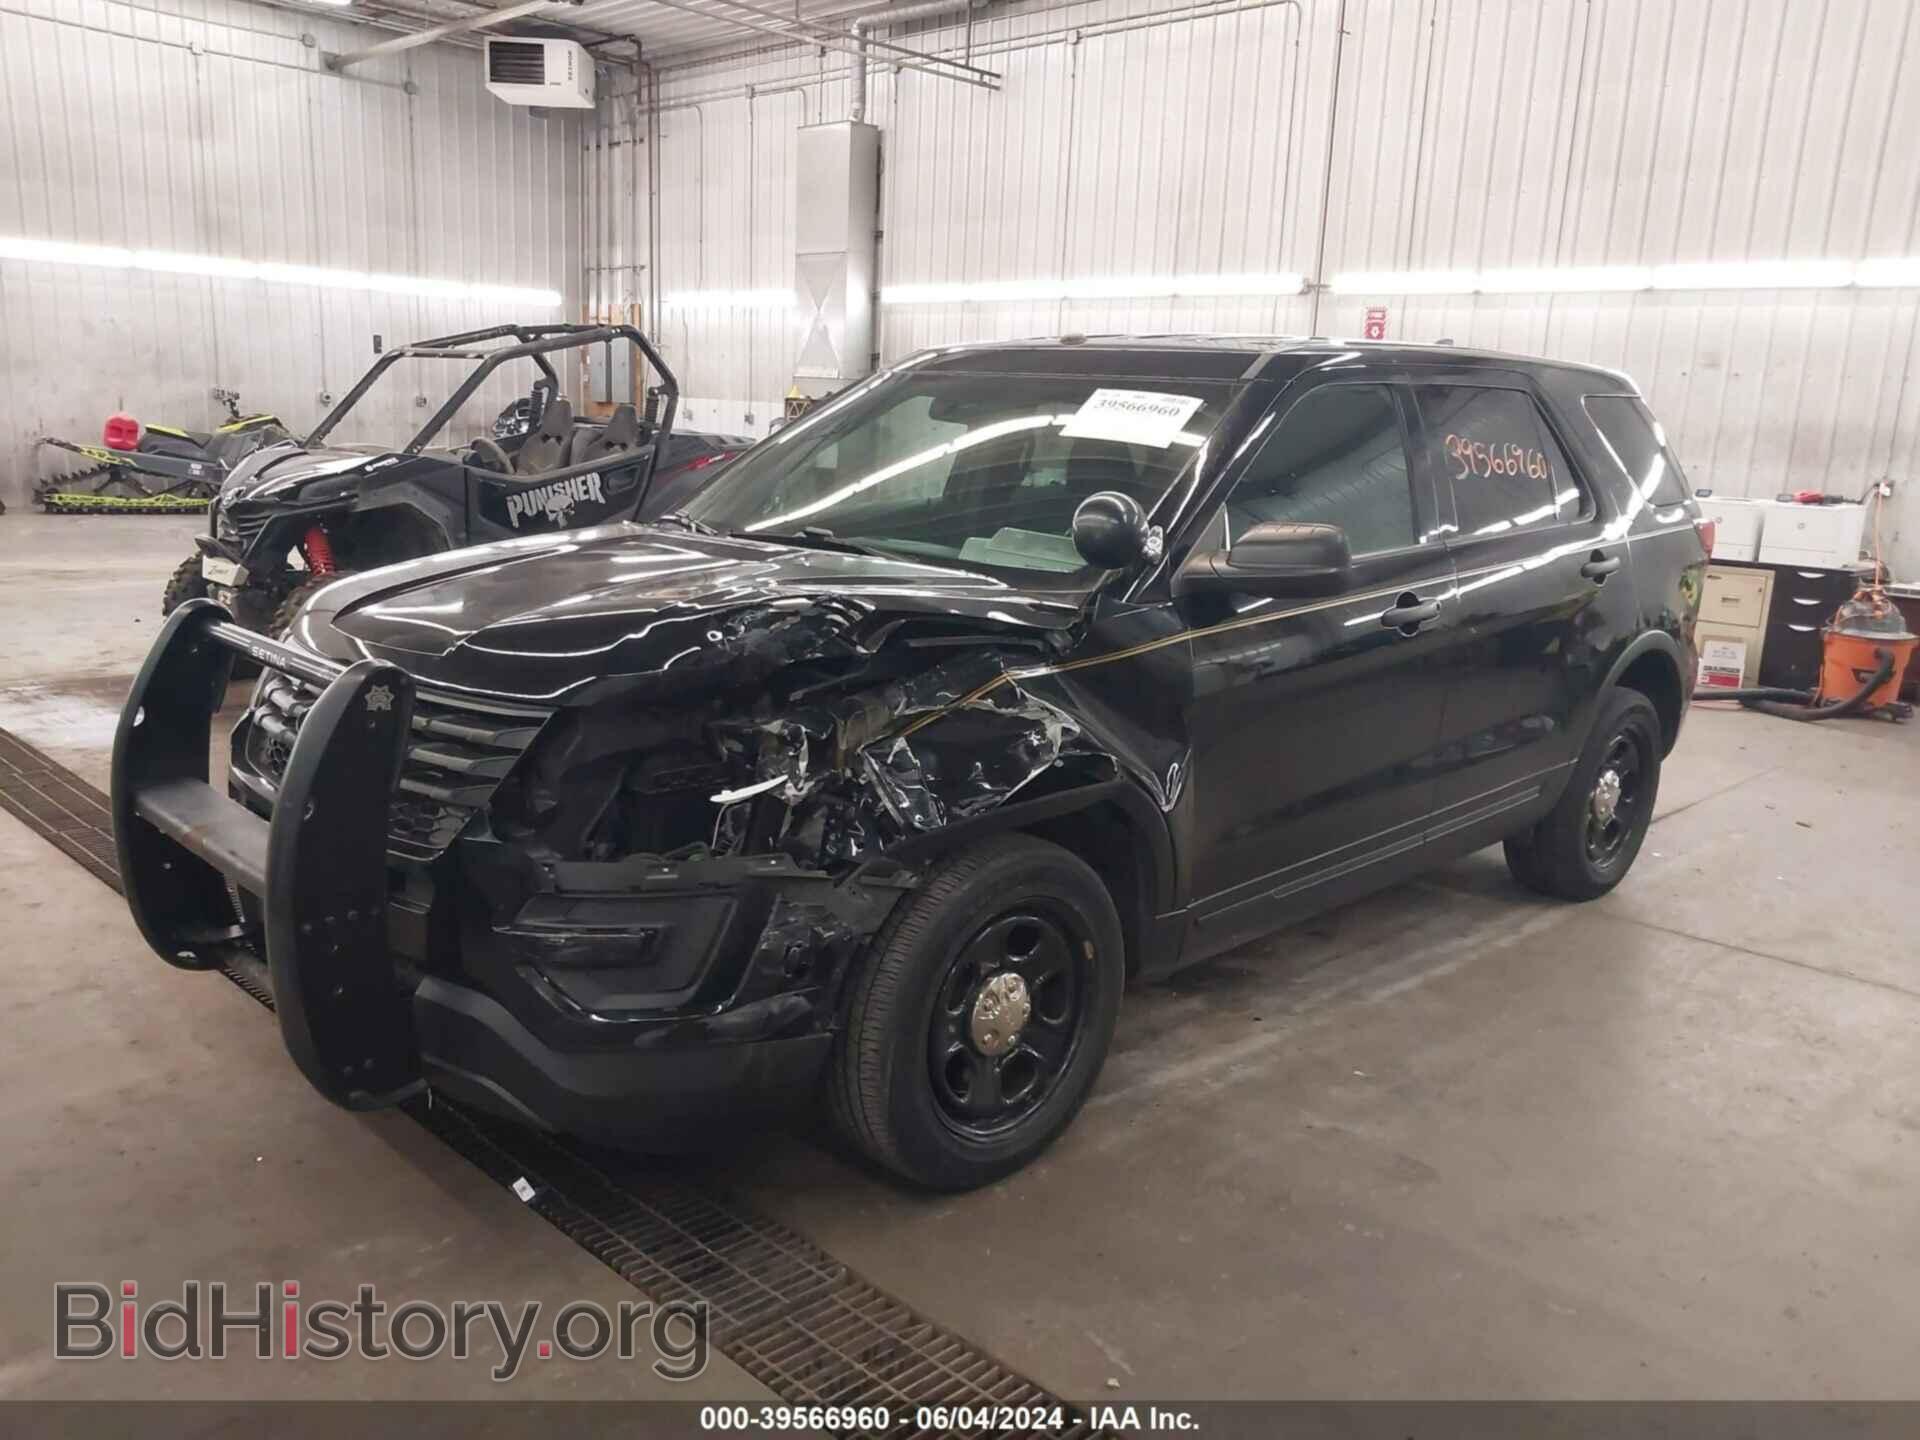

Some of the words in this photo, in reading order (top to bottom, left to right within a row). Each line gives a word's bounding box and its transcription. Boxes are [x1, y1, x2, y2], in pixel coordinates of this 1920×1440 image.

[1094, 398, 1182, 417] 39566960
[1445, 434, 1547, 480] 39566960
[506, 472, 606, 528] PUNISHER
[251, 645, 287, 669] SETINA
